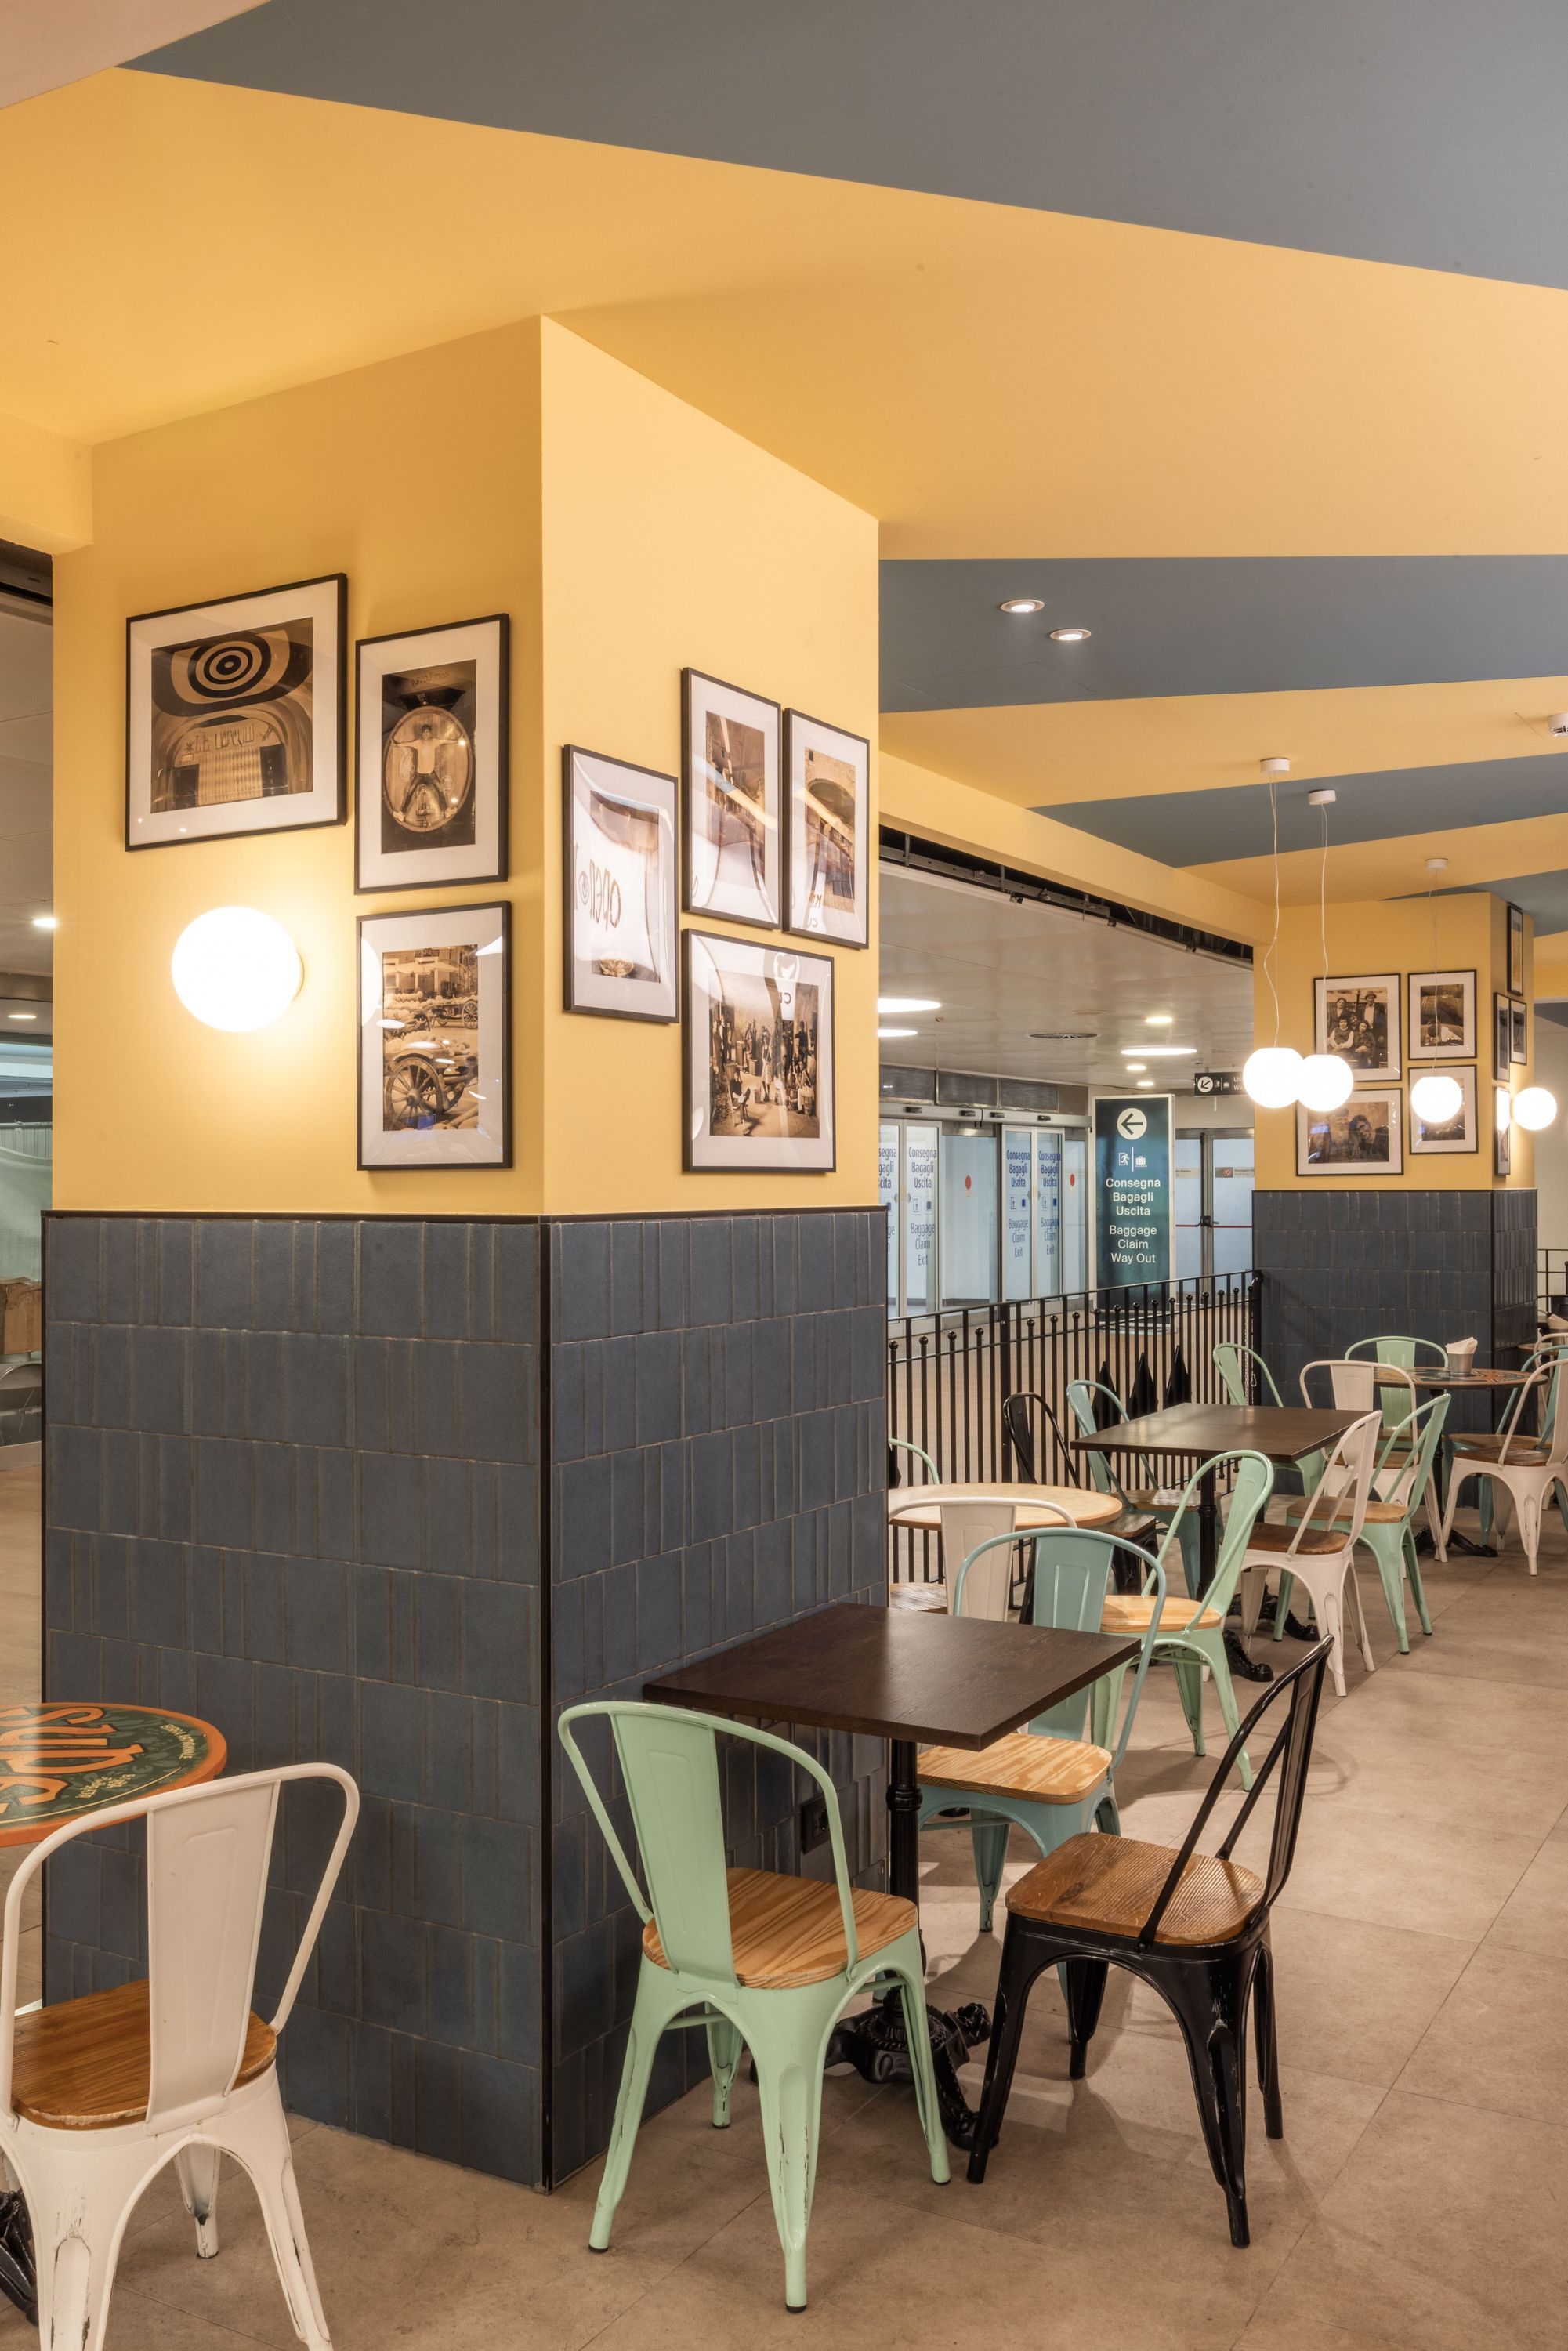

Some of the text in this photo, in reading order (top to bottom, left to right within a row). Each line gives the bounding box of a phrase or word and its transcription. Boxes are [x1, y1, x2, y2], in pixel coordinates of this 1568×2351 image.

[879, 1147, 897, 1161] segna
[908, 1147, 937, 1161] Consegna
[1006, 1150, 1030, 1164] Consegna
[1038, 1150, 1061, 1162] Consegna
[879, 1161, 894, 1176] gagli
[911, 1161, 934, 1176] Bagagli
[1009, 1163, 1028, 1177] Bagagli
[1041, 1164, 1059, 1178] Bagagli
[914, 1177, 932, 1189] Uscita
[1011, 1177, 1026, 1188] Uscita
[1043, 1177, 1058, 1187] Uscita
[1106, 1178, 1161, 1190] Consegna
[1113, 1192, 1153, 1204] Bagagli
[1116, 1206, 1151, 1215] Uscita
[911, 1223, 936, 1237] Baggage
[1009, 1218, 1028, 1231] Baggage
[1041, 1217, 1059, 1231] Baggage
[1044, 1230, 1057, 1242] Claim
[1109, 1225, 1157, 1237] Baggage
[915, 1238, 931, 1250] Claim
[1012, 1232, 1025, 1244] Claim
[1117, 1239, 1149, 1249] Claim
[1014, 1248, 1023, 1258] Exit
[1046, 1244, 1055, 1255] Exit
[918, 1254, 929, 1266] Exit
[1110, 1253, 1156, 1265] Way Out
